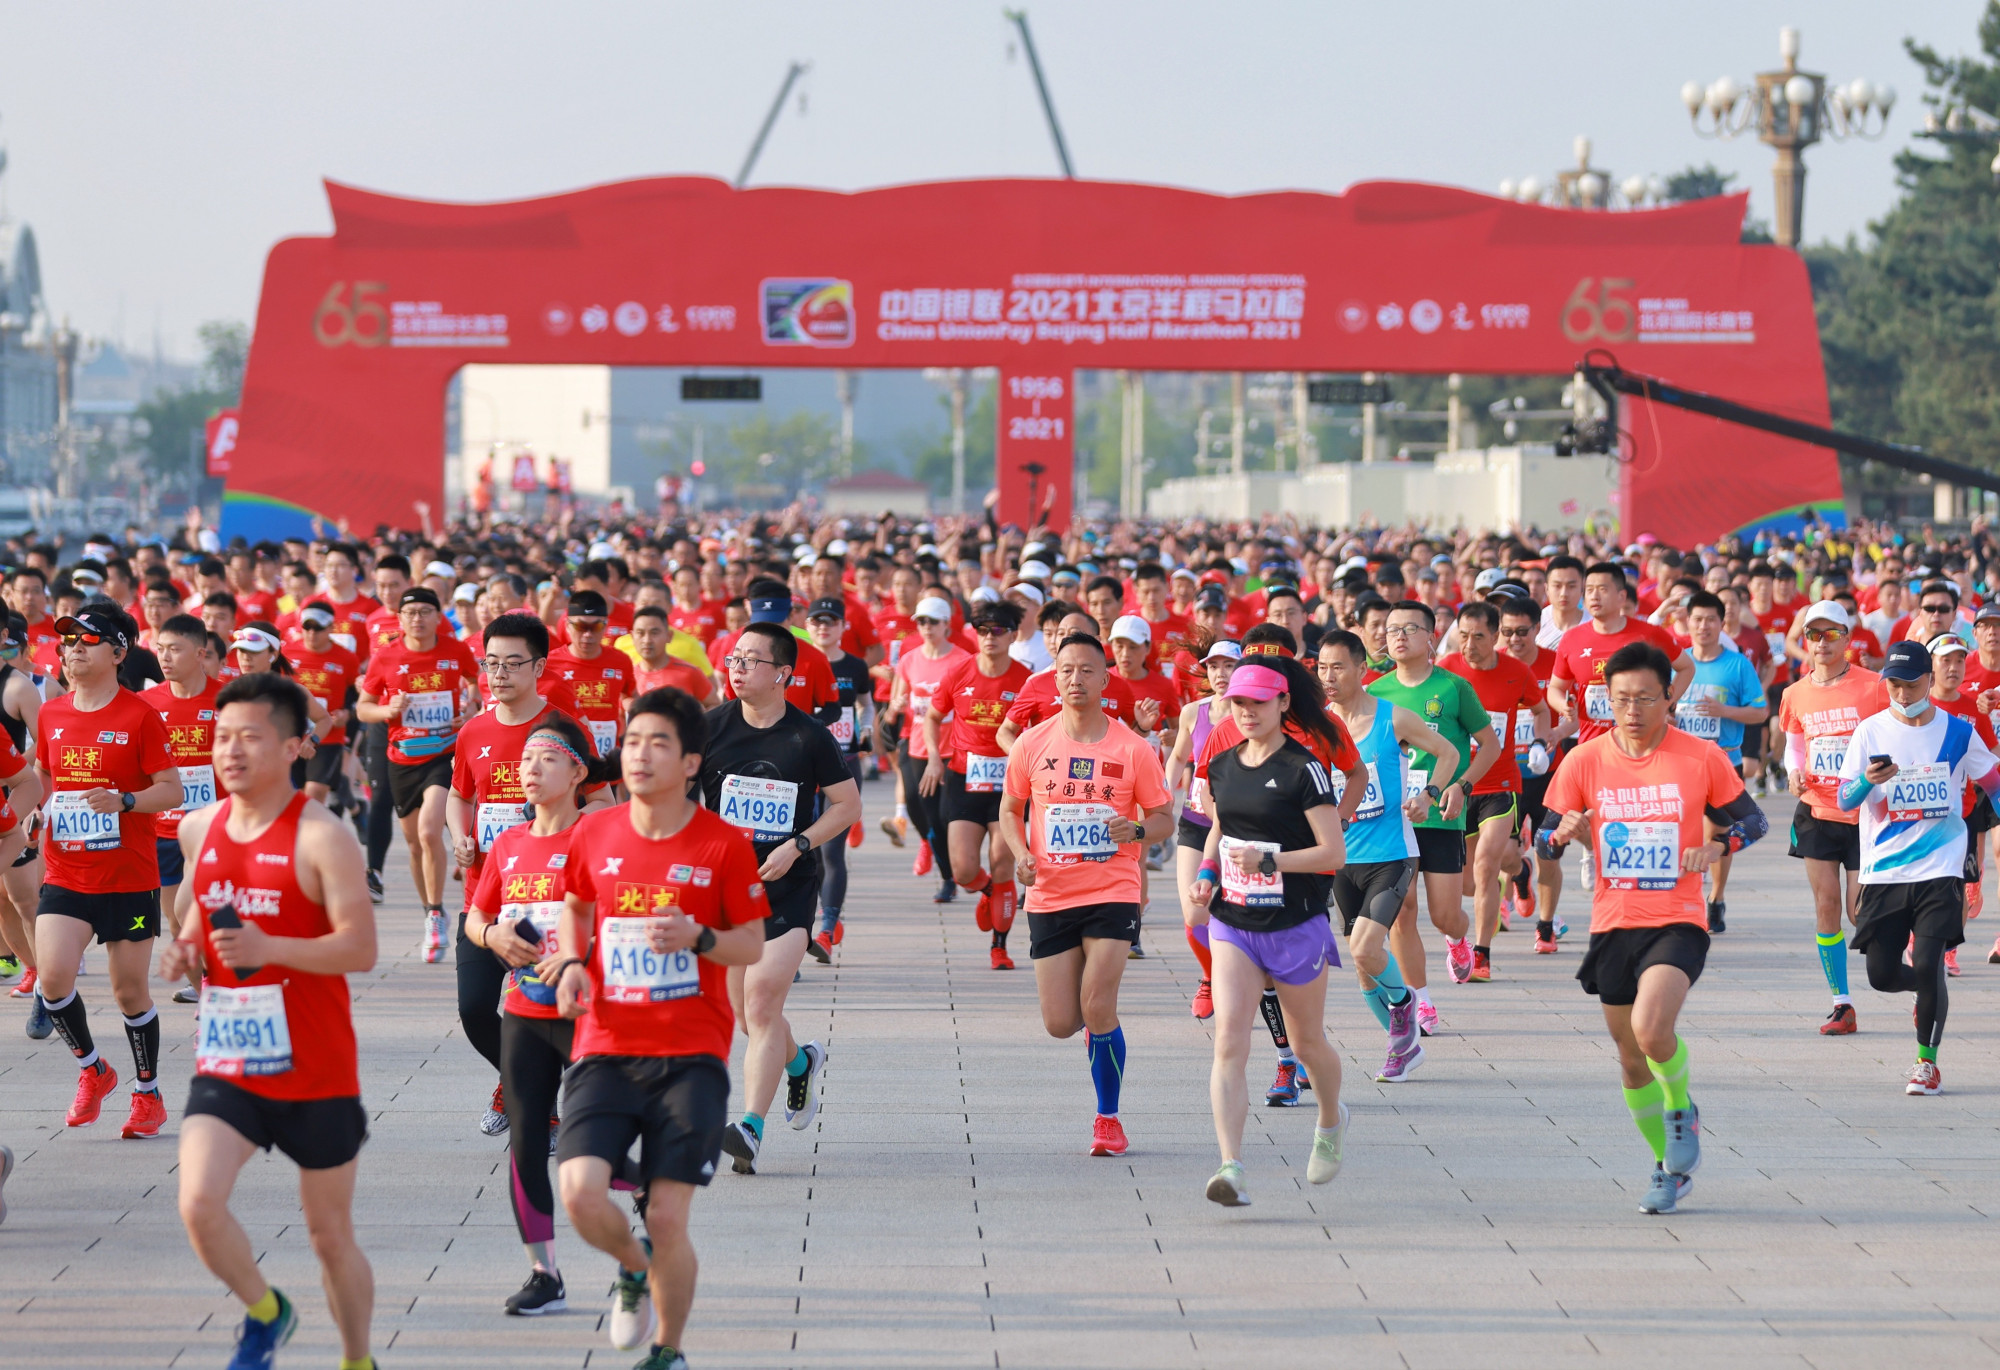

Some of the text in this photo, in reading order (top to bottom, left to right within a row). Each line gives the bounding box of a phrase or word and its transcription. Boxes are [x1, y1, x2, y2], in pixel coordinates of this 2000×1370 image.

[312, 281, 389, 347] 65
[880, 289, 1305, 321] 中国银联 2021北京半程马拉松
[1560, 277, 1636, 343] 65
[877, 321, 1300, 344] China UnionPay Beijing Half Marathon 2021
[1008, 376, 1064, 399] 1956
[211, 418, 239, 460] A
[1008, 416, 1064, 440] 2021
[515, 458, 535, 482] A
[1245, 644, 1280, 656] 中国
[411, 672, 442, 690] 北京
[576, 681, 608, 697] 北京
[406, 709, 450, 724] A1440
[971, 702, 1004, 717] 北京
[170, 727, 204, 744] 北京
[1679, 717, 1717, 732] A1606
[63, 749, 99, 769] 北京
[970, 762, 1005, 778] A123
[183, 783, 211, 804] 076
[1045, 780, 1116, 801] 中国警察
[1597, 784, 1684, 804] 尖叫就赢
[1892, 781, 1948, 805] A2096
[724, 796, 789, 825] A1936
[1602, 801, 1683, 822] 赢就尖叫
[56, 811, 113, 834] A1016
[1051, 824, 1111, 847] A1264
[1607, 846, 1672, 869] A2212
[507, 875, 551, 900] 北京
[619, 887, 675, 912] 北京
[1258, 896, 1283, 905] 北京现代
[610, 945, 690, 977] A1676
[668, 986, 699, 999] 北京现代
[206, 1016, 277, 1049] A1591
